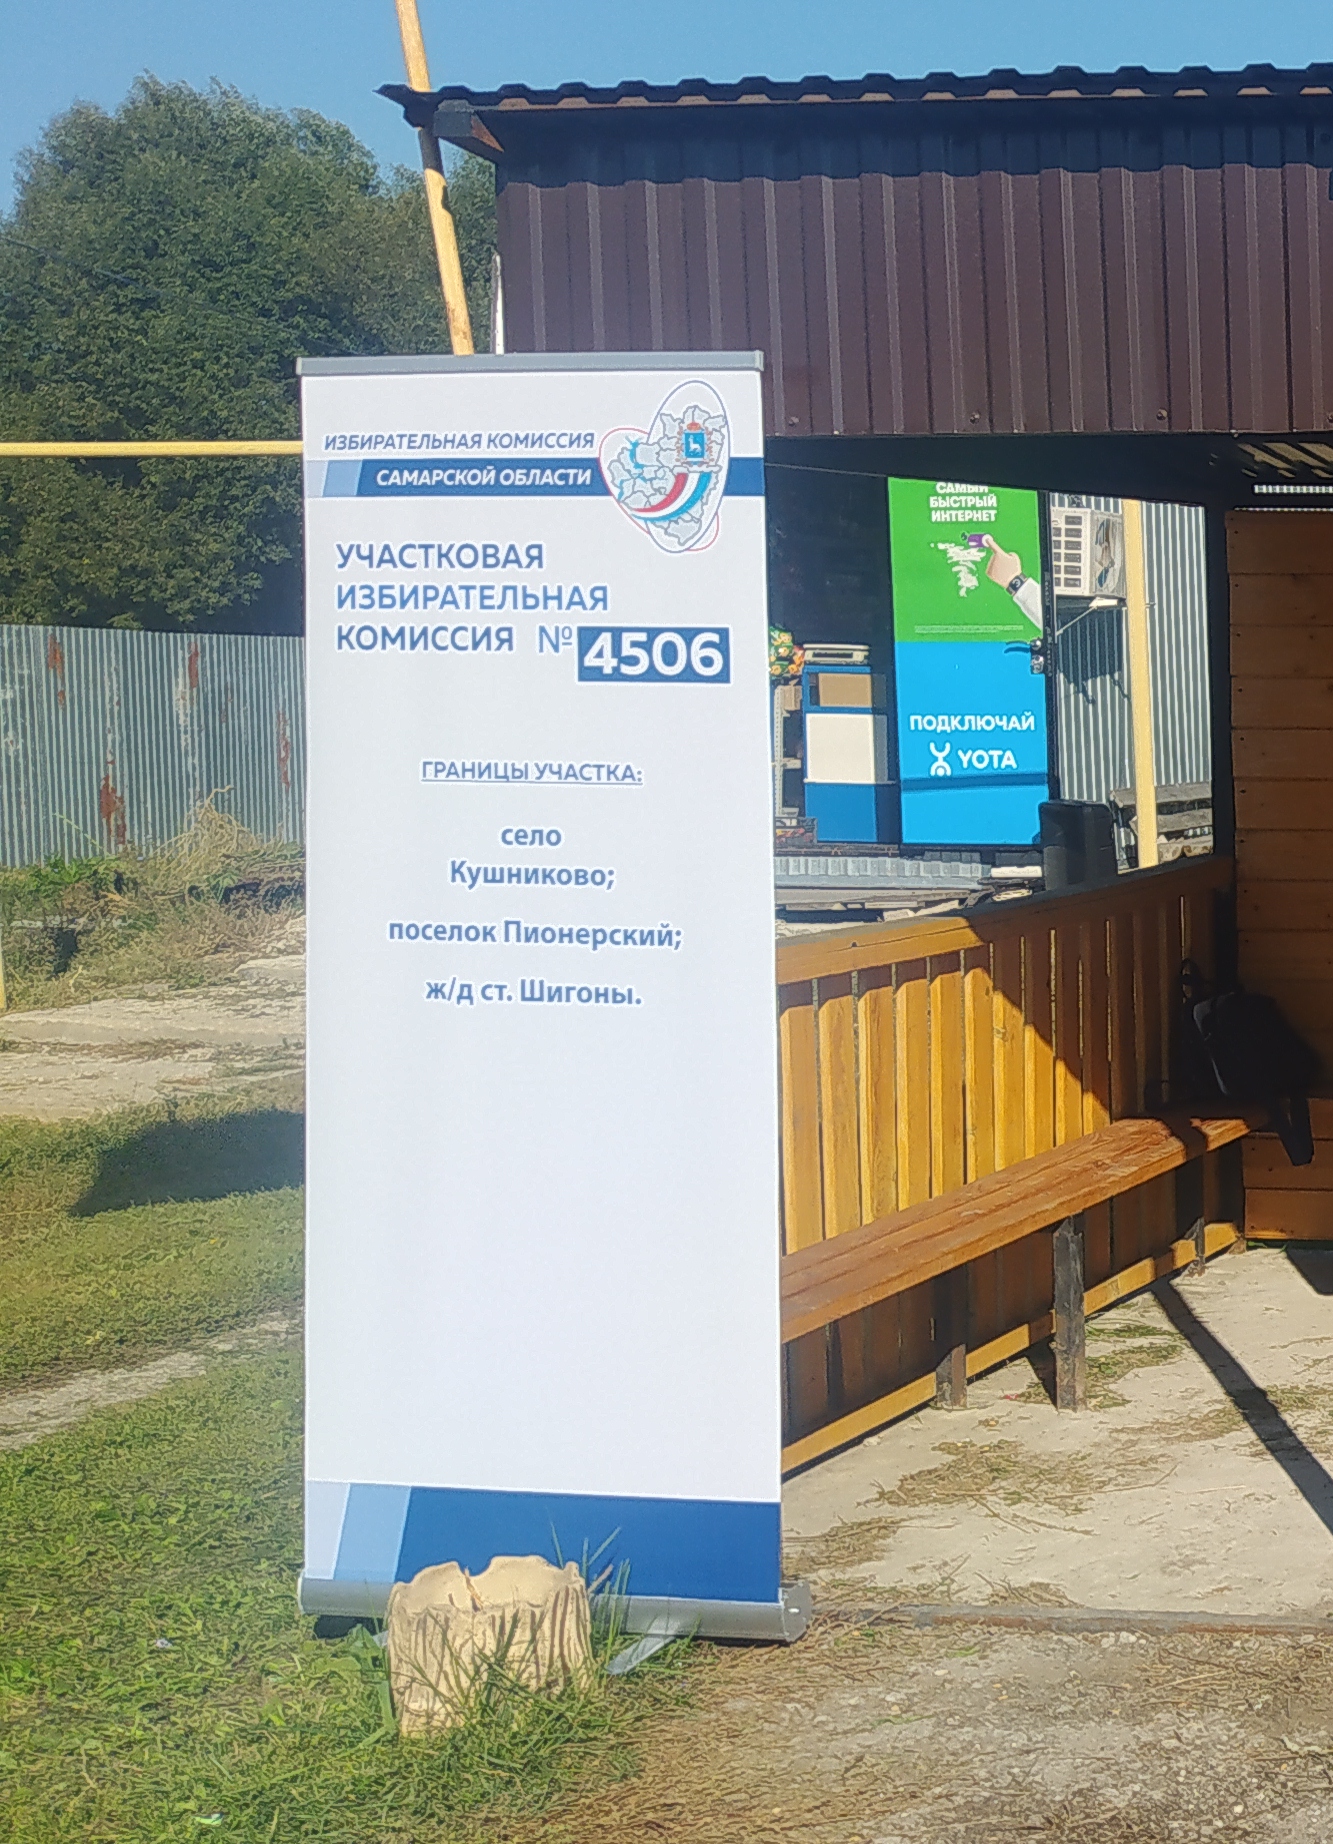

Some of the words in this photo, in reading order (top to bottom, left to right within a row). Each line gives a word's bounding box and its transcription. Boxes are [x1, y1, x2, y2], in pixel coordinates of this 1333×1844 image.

[324, 433, 482, 451] ИЗБИРАТЕЛЬНАЯ
[487, 432, 595, 450] КОМИССИЯ
[376, 465, 496, 486] САМАРСКОЙ
[499, 468, 592, 487] ОБЛАСТИ
[929, 493, 998, 508] БЫСТРЫЙ
[931, 509, 998, 523] ИНТЕРНЕТ
[336, 543, 544, 569] УЧАСТКОВАЯ
[336, 584, 609, 611] ИЗБИРАТЕЛЬНАЯ
[336, 625, 515, 653] КОМИССИЯ
[538, 625, 573, 653] №
[583, 630, 725, 677] 4506
[910, 712, 1035, 733] ПОДКЛЮЧАЙ
[958, 749, 1017, 769] YOTA
[421, 761, 529, 782] ГРАНИЦЫ
[534, 763, 643, 784] УЧАСТКА:
[500, 827, 562, 847] село
[450, 860, 615, 890] Кушниково;
[388, 922, 497, 943] поселок
[504, 921, 683, 950] Пионерский;
[425, 978, 474, 1004] ж/д
[480, 982, 513, 1002] ст.
[520, 979, 643, 1005] Шигоны.
